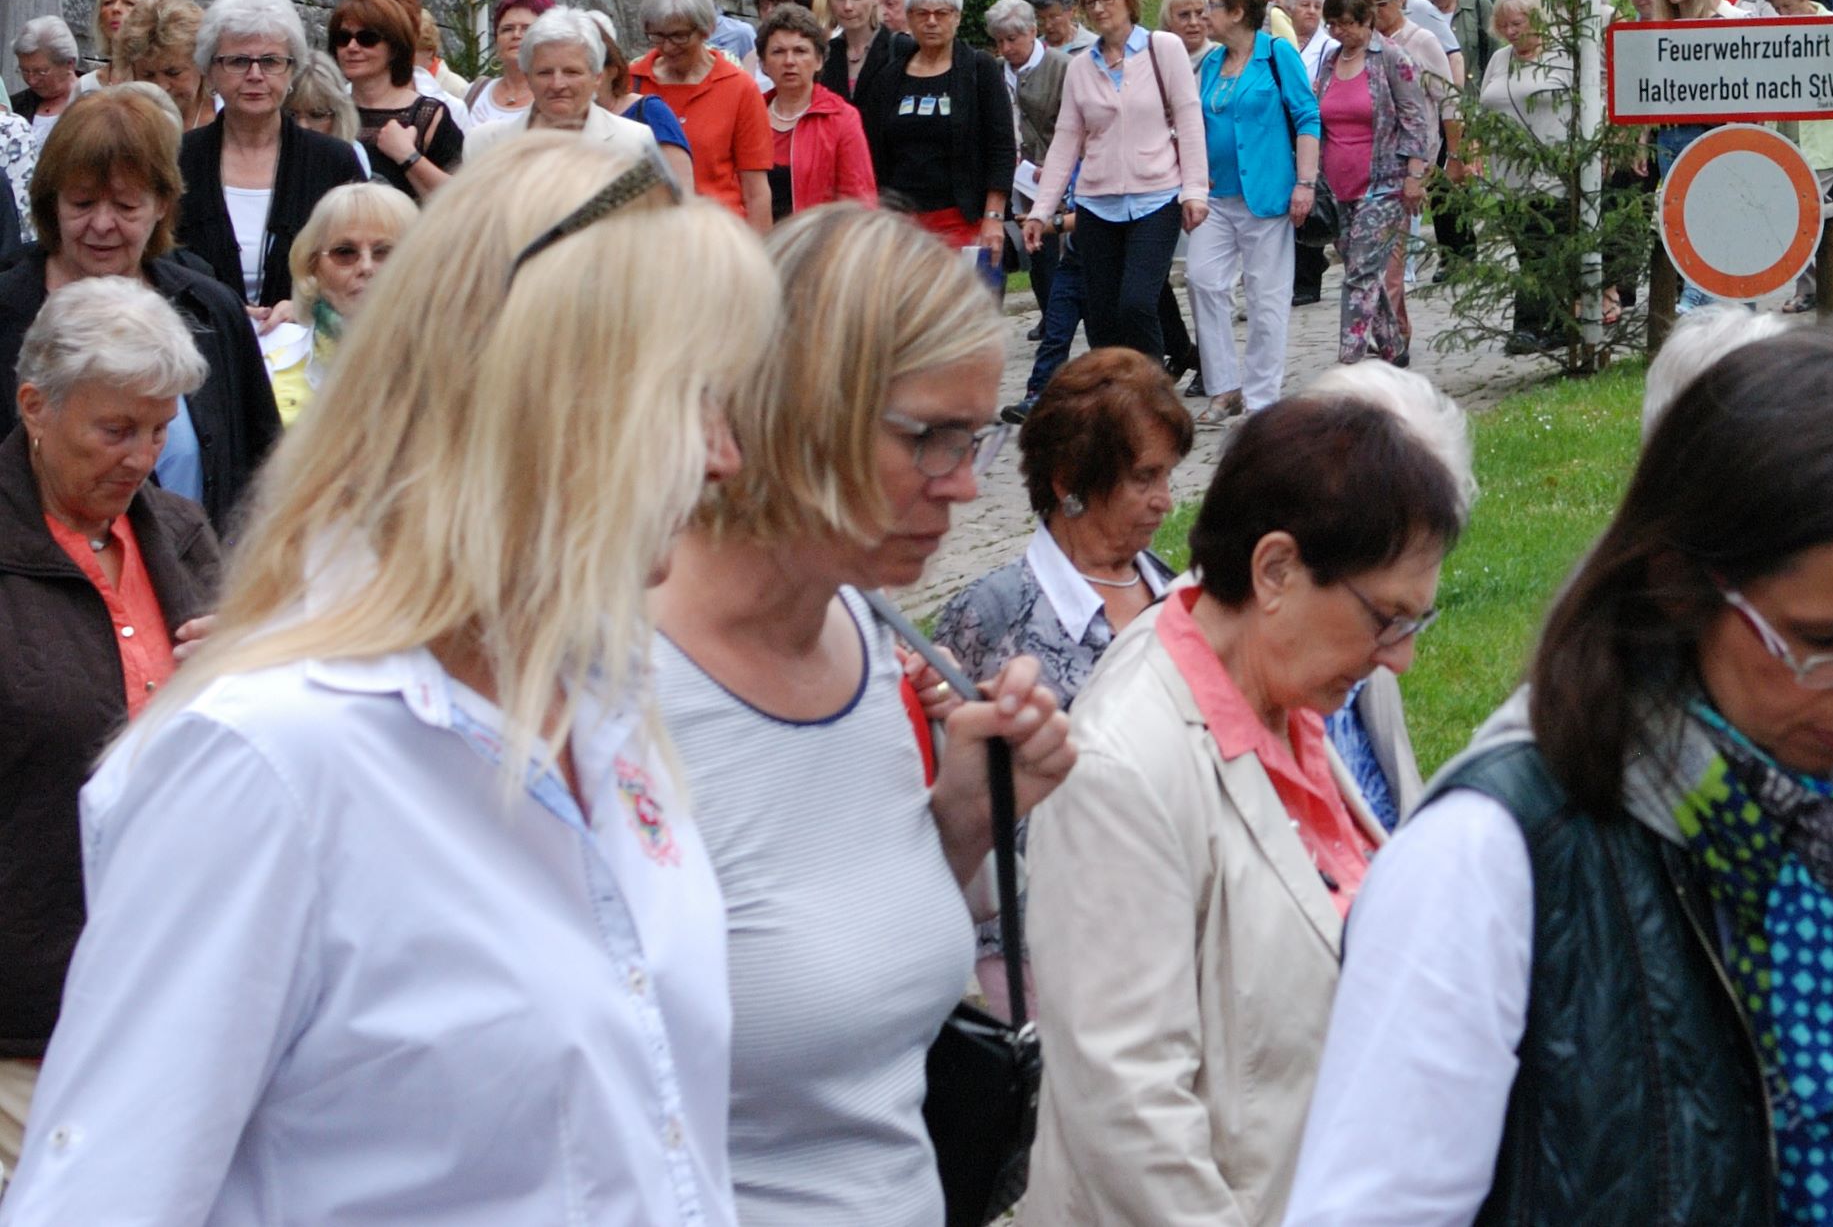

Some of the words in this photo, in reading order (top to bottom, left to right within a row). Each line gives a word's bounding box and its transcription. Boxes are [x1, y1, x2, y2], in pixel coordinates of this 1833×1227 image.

[1658, 34, 1831, 62] Feuerwehrzufahrt
[1639, 77, 1749, 103] Halteverbot
[1756, 75, 1802, 99] nach
